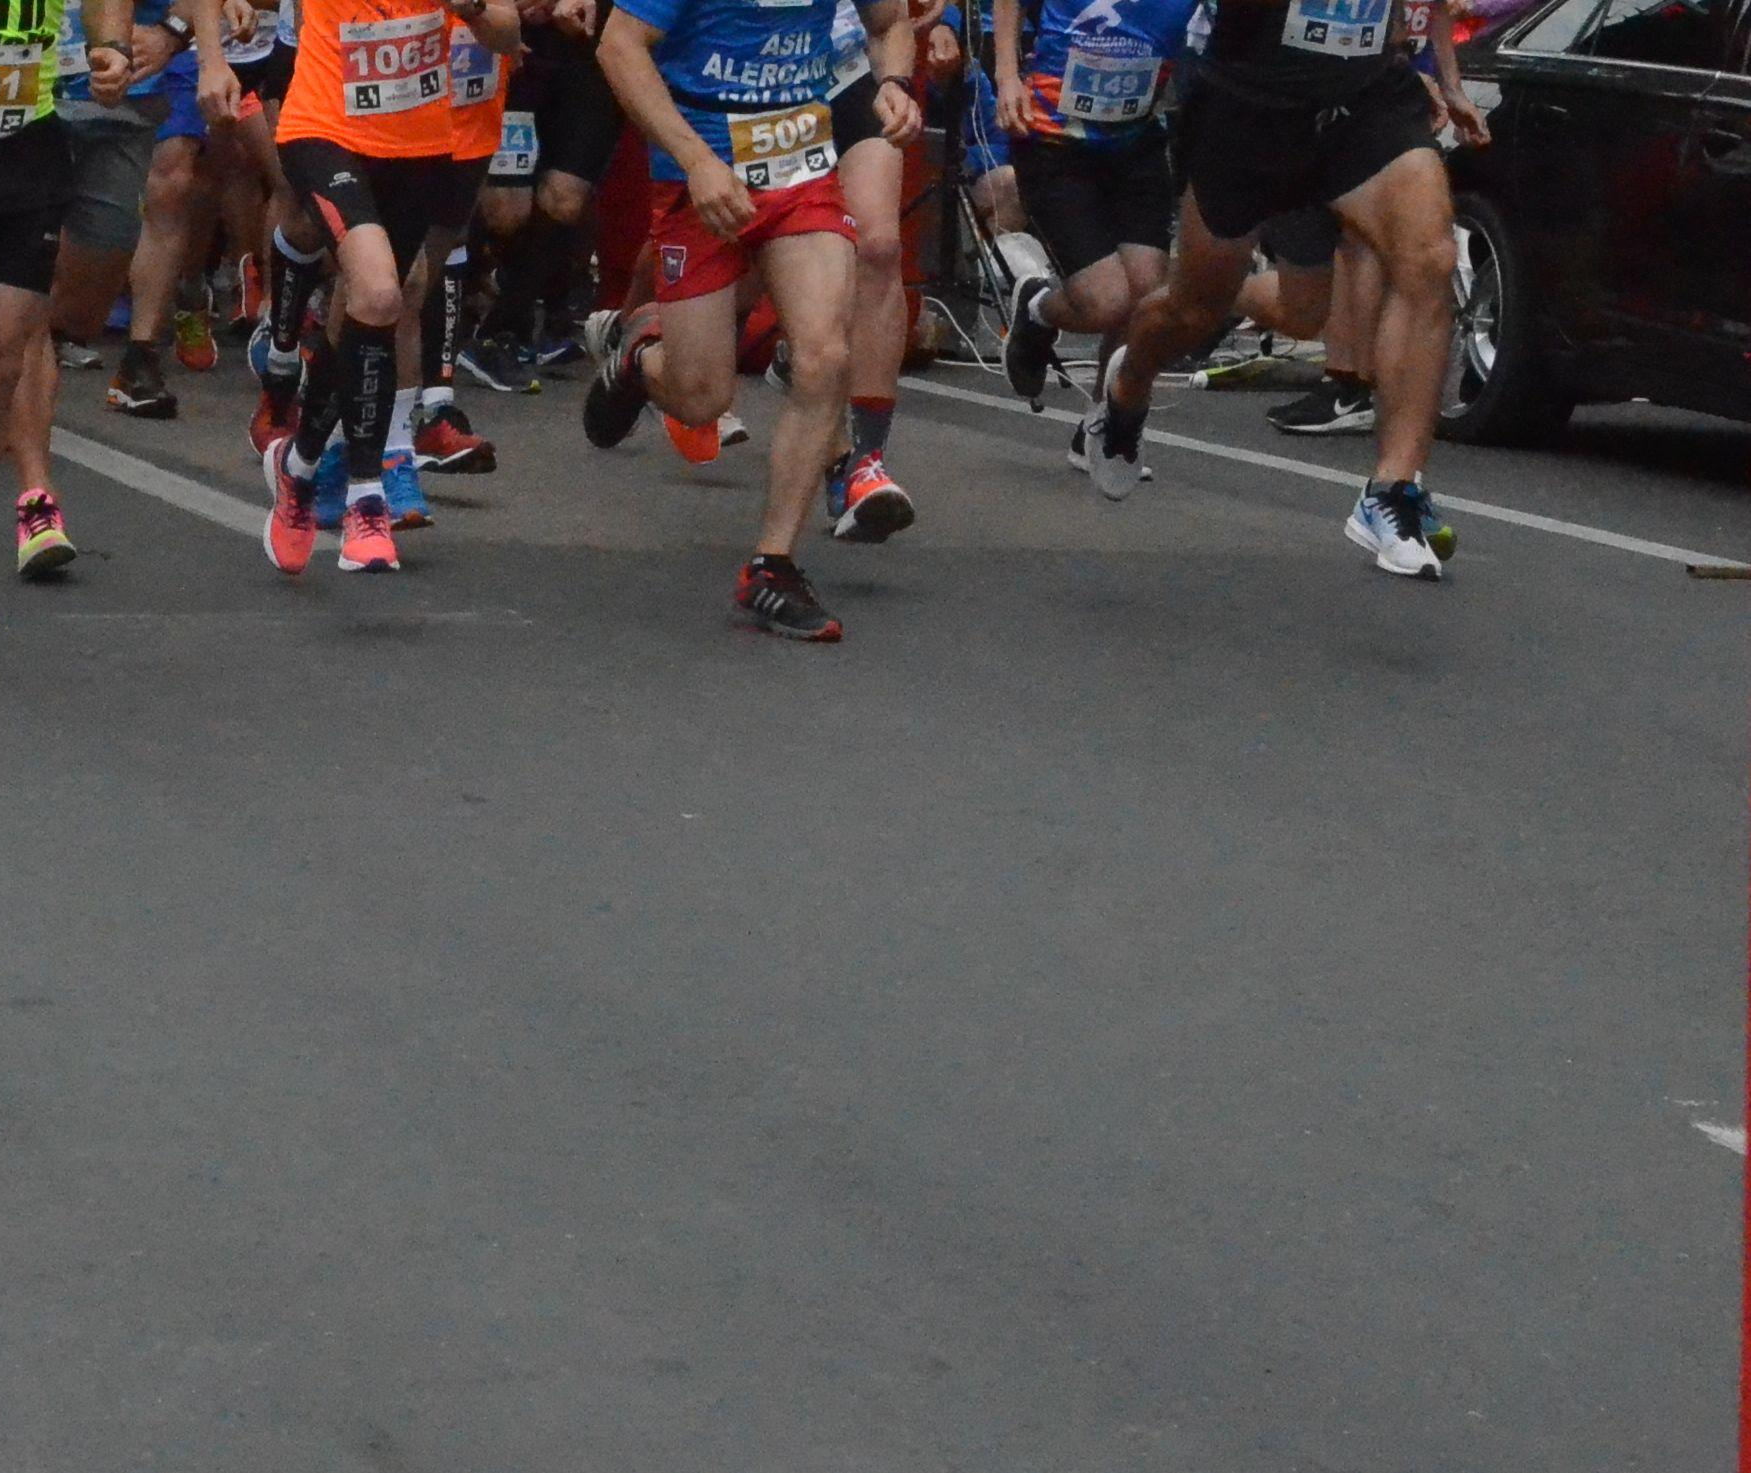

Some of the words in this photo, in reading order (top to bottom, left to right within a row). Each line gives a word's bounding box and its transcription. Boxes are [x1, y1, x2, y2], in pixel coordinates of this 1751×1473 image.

[349, 34, 441, 77] 1065
[1088, 73, 1138, 95] 149
[751, 112, 818, 154] 500
